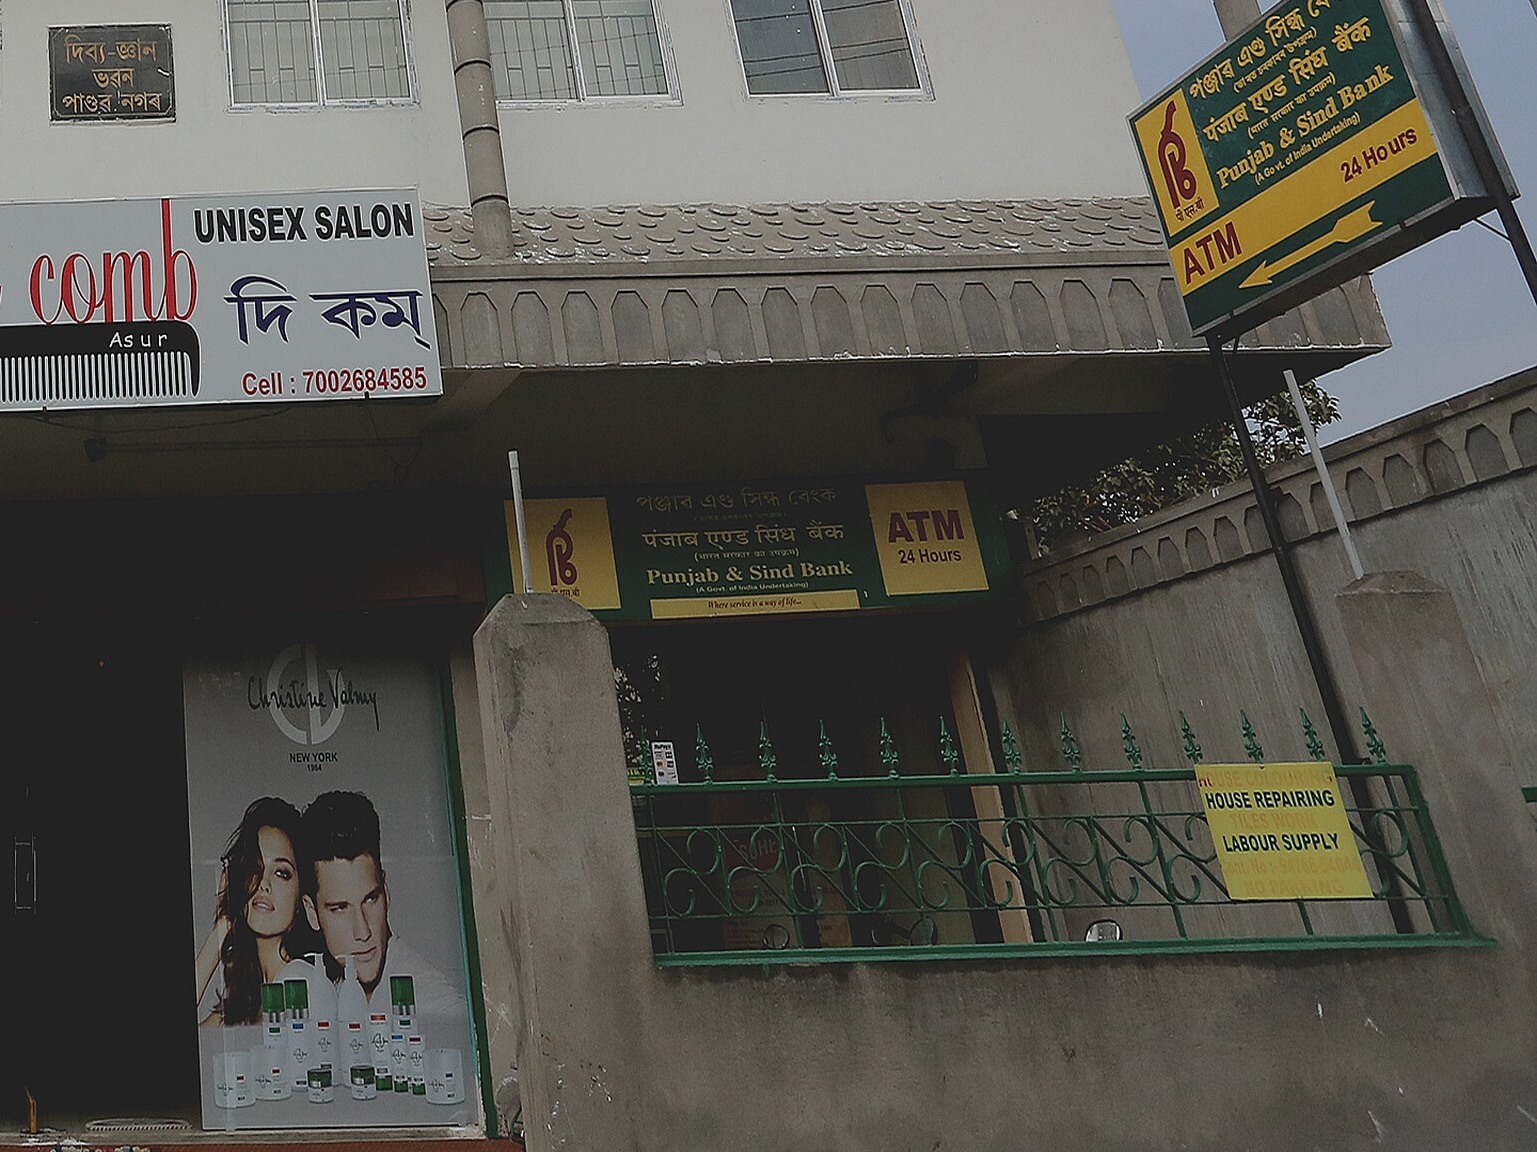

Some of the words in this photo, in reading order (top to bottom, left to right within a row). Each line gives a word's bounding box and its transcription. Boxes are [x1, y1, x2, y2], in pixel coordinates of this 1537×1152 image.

[1248, 74, 1288, 114] एण्ड
[1216, 140, 1274, 189] Punjab
[1279, 127, 1296, 149] &
[1296, 96, 1339, 138] Sind
[1337, 64, 1395, 111] Bank
[1293, 138, 1312, 159] India
[1312, 111, 1361, 148] Undertaking)
[1339, 155, 1363, 184] 24
[1361, 127, 1418, 170] Hours
[193, 206, 307, 243] UNISEX
[314, 202, 414, 241] SALON
[29, 198, 198, 326] comb
[1182, 220, 1243, 285] ATM
[223, 274, 297, 346] দি
[108, 331, 168, 348] Asur
[241, 370, 283, 396] Cell
[302, 366, 428, 395] 7002684585
[641, 528, 699, 548] पंजाब
[704, 529, 750, 550] एण्ड
[805, 519, 844, 540] बैंक
[887, 508, 965, 545] ATM
[898, 549, 917, 564] 24
[919, 547, 962, 564] Hours
[646, 567, 720, 587] Punjab
[725, 565, 744, 581] &
[749, 563, 795, 580] Sind
[799, 560, 854, 577] Bank
[248, 675, 327, 709] Christine
[289, 752, 310, 763] NEW
[312, 752, 338, 762] YORK
[1205, 792, 1252, 809] HOUSE
[1254, 790, 1335, 808] REPAIRING
[1222, 834, 1280, 852] LABOUR
[1281, 832, 1339, 851] SUPPLY
